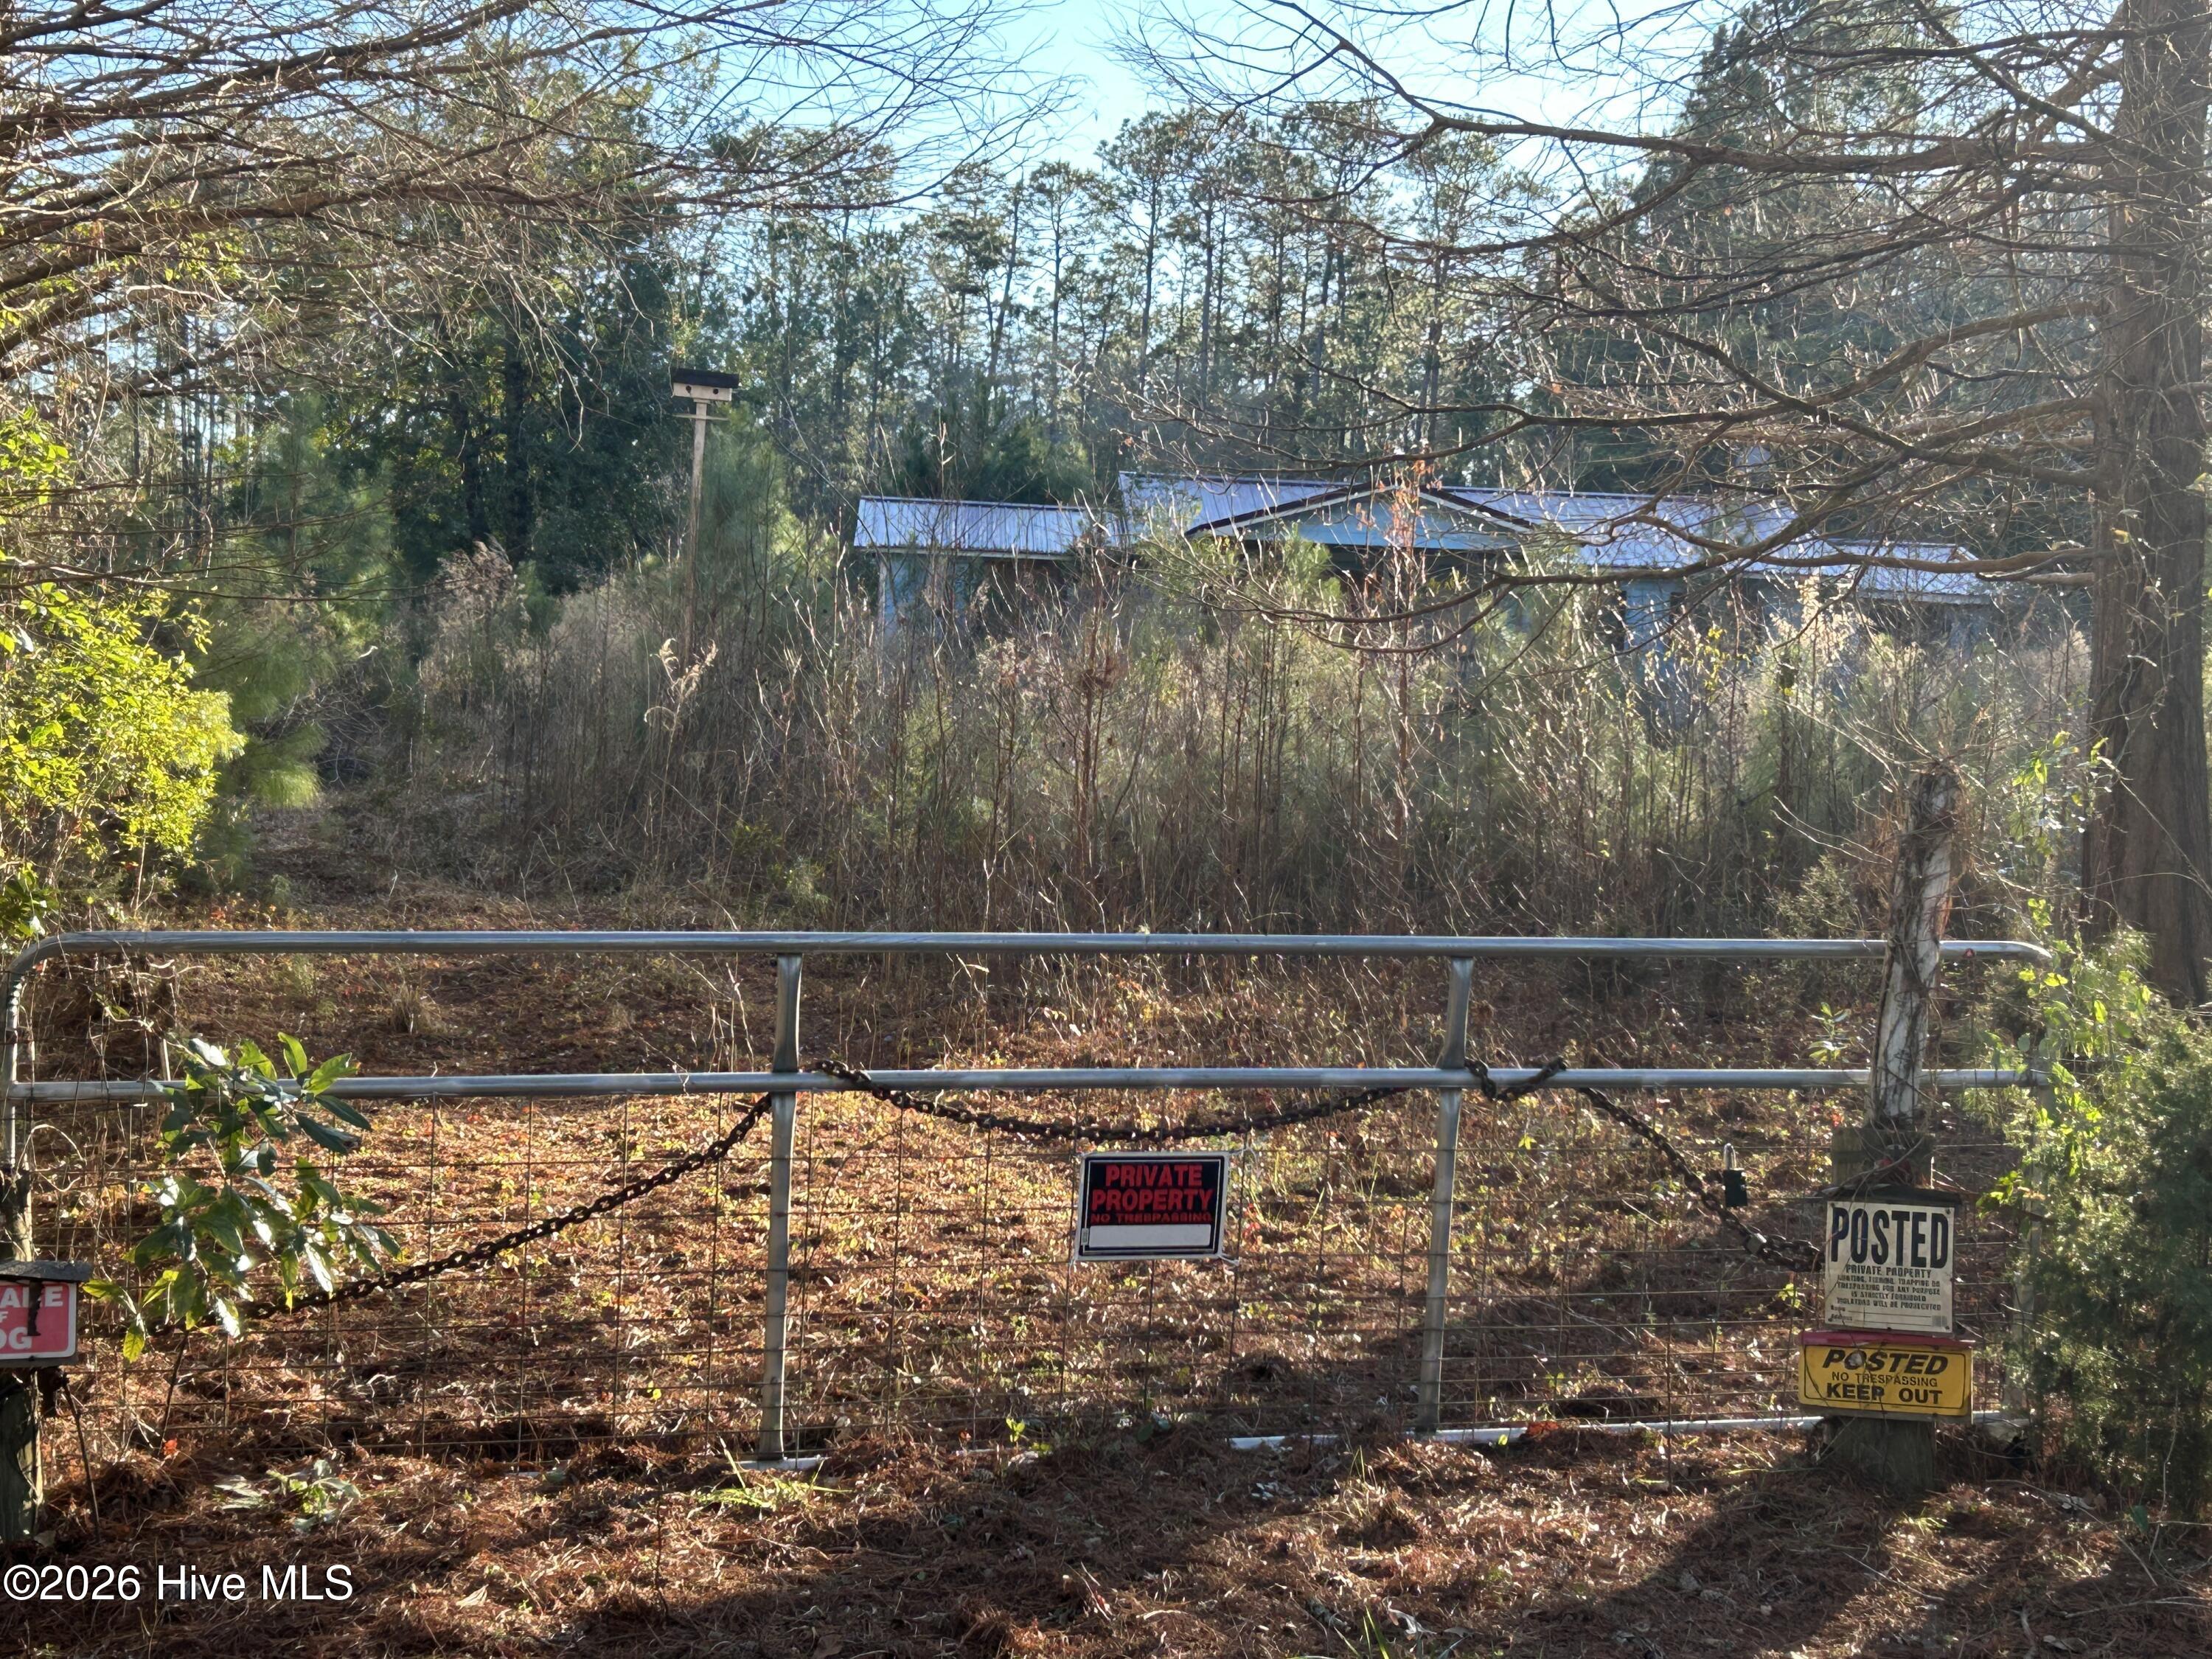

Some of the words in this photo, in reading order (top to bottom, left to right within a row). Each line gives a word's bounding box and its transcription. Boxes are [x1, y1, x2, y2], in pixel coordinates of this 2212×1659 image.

[1106, 1164, 1203, 1186] PRIVATE
[1091, 1189, 1213, 1211] PROPERTY
[1091, 1214, 1110, 1223] NO
[1116, 1211, 1211, 1223] TRESPASSING
[1831, 1207, 1949, 1268] POSTED
[1846, 1265, 1882, 1275] PRIVATE
[1886, 1267, 1931, 1278] PROPERTY
[1822, 1349, 1949, 1375] POSTED
[1832, 1371, 1849, 1381] NO
[1855, 1373, 1938, 1387] TRESPASSING
[1826, 1382, 1885, 1401] KEEP
[1899, 1388, 1943, 1405] OUT
